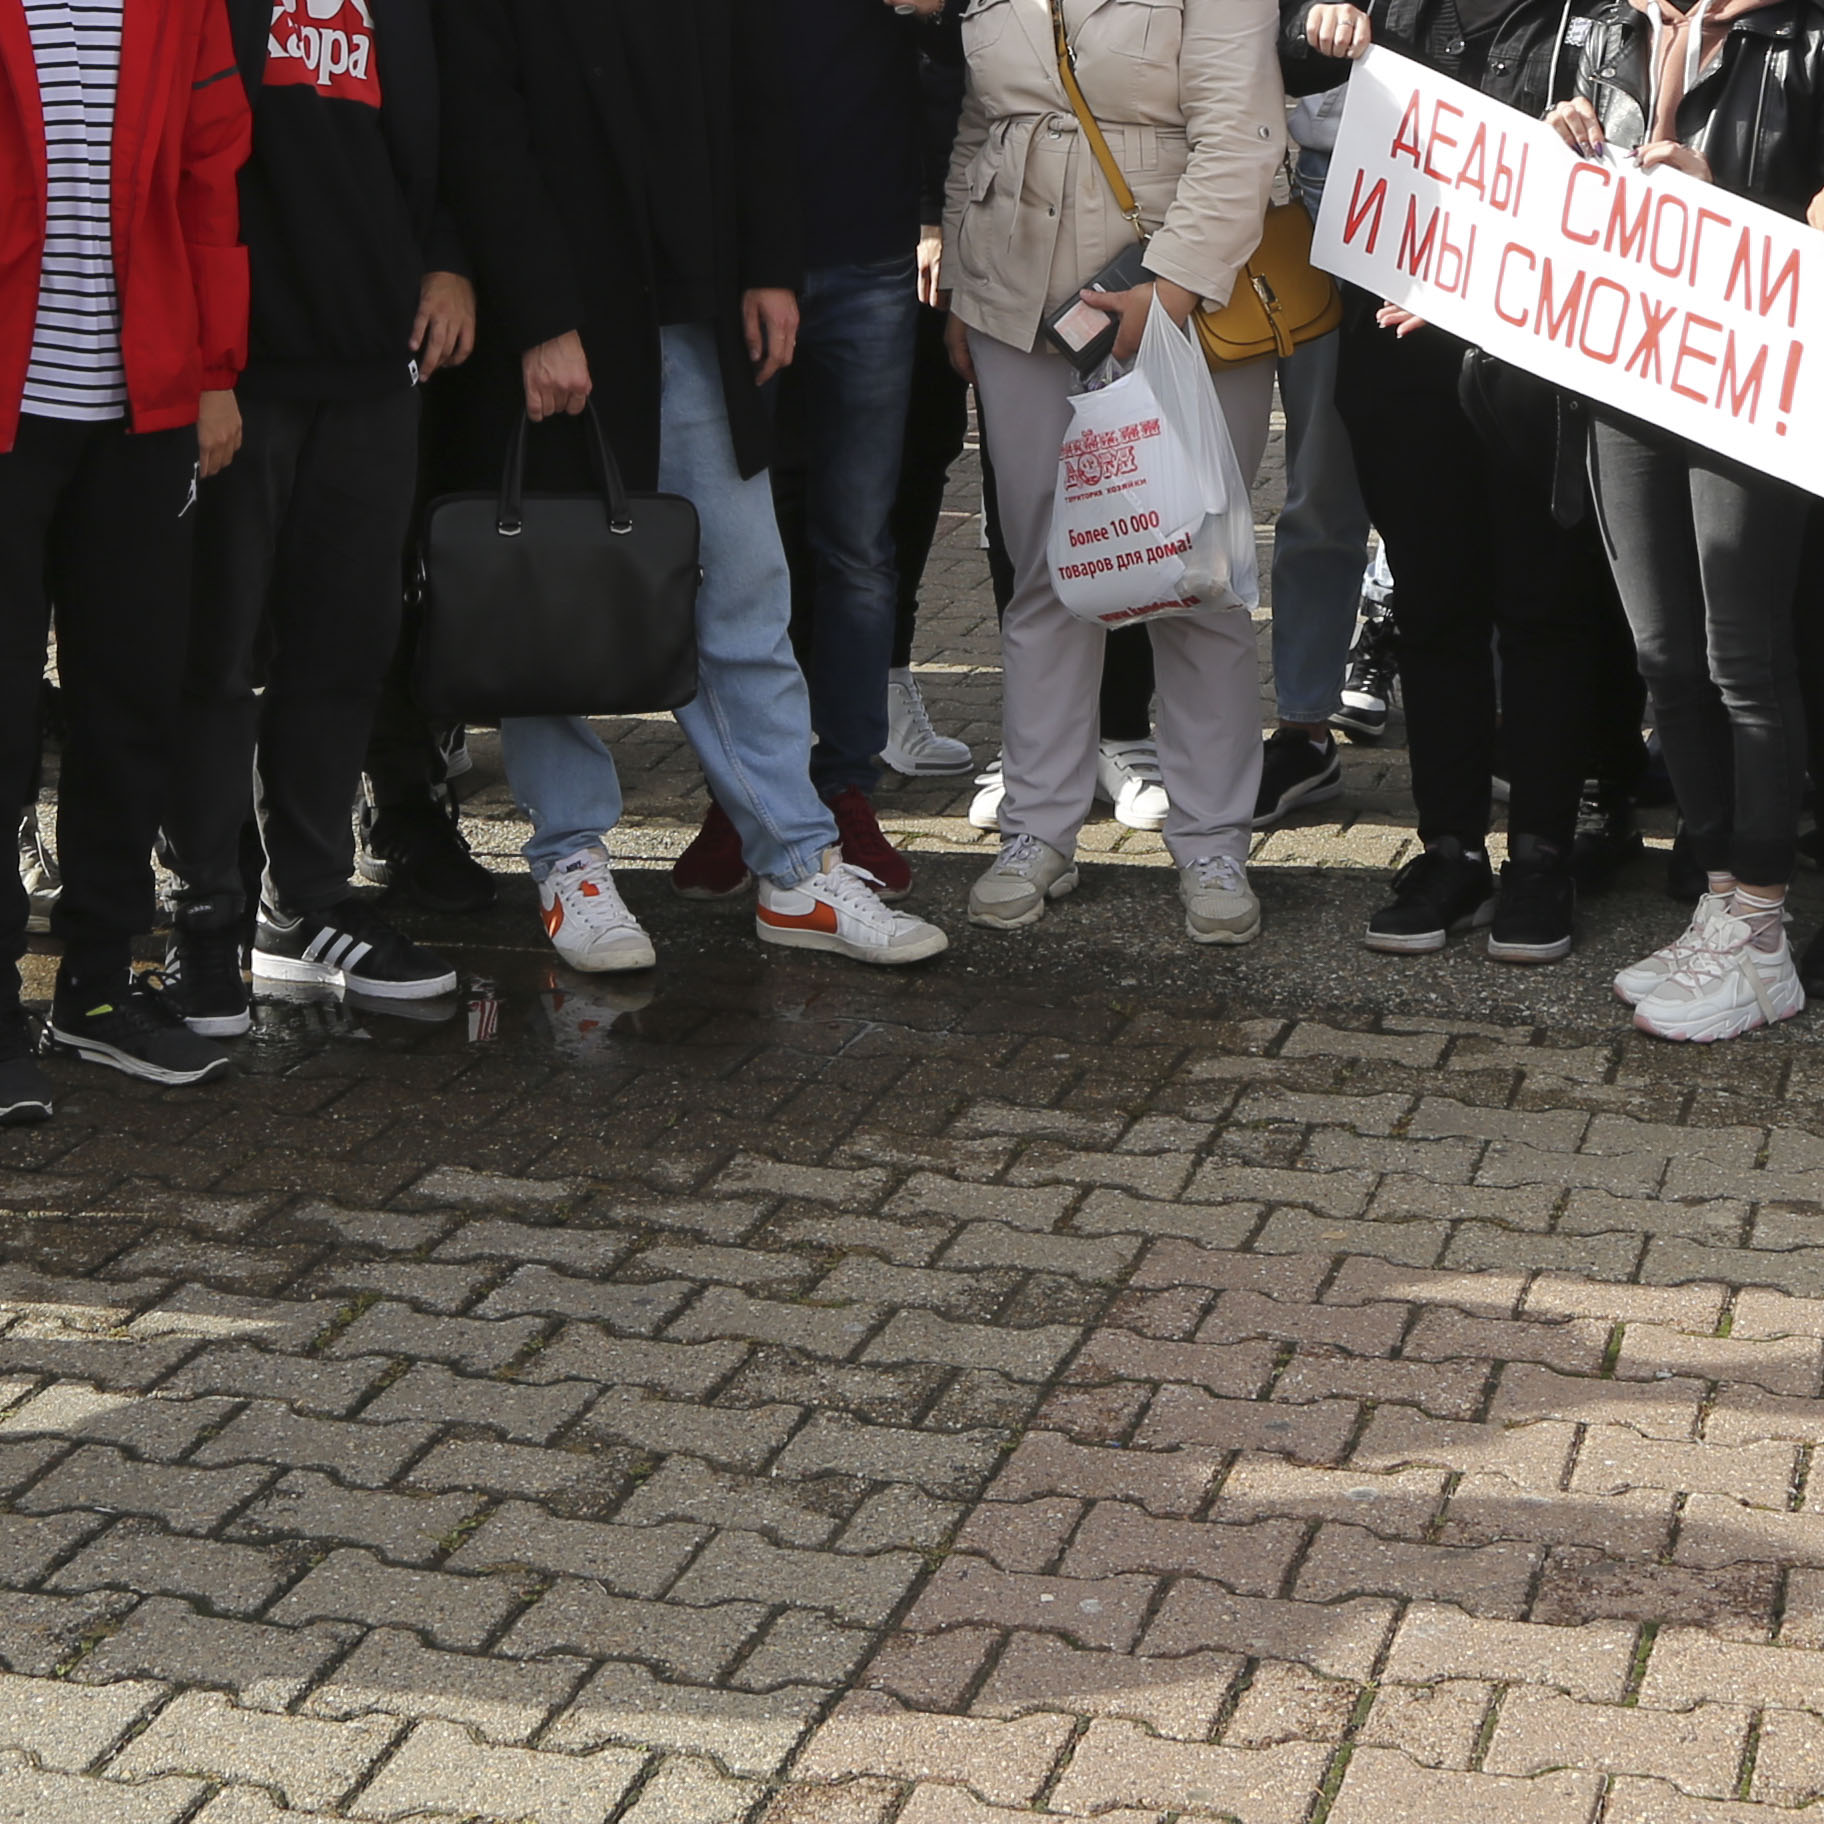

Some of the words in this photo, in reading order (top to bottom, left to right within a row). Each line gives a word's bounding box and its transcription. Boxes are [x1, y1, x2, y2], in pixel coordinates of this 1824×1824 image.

[1390, 88, 1529, 217] ДЕДЫ
[1560, 161, 1801, 328] СМОГЛИ
[1343, 167, 1389, 254] И
[1396, 192, 1477, 300] МЫ
[1494, 242, 1804, 437] СМОЖЕМ!
[1058, 556, 1114, 581] товаров
[1115, 549, 1144, 572] для
[1145, 531, 1194, 565] дома!
[1067, 527, 1110, 548] Более
[1110, 518, 1129, 538] 10
[1130, 509, 1160, 533] 000
